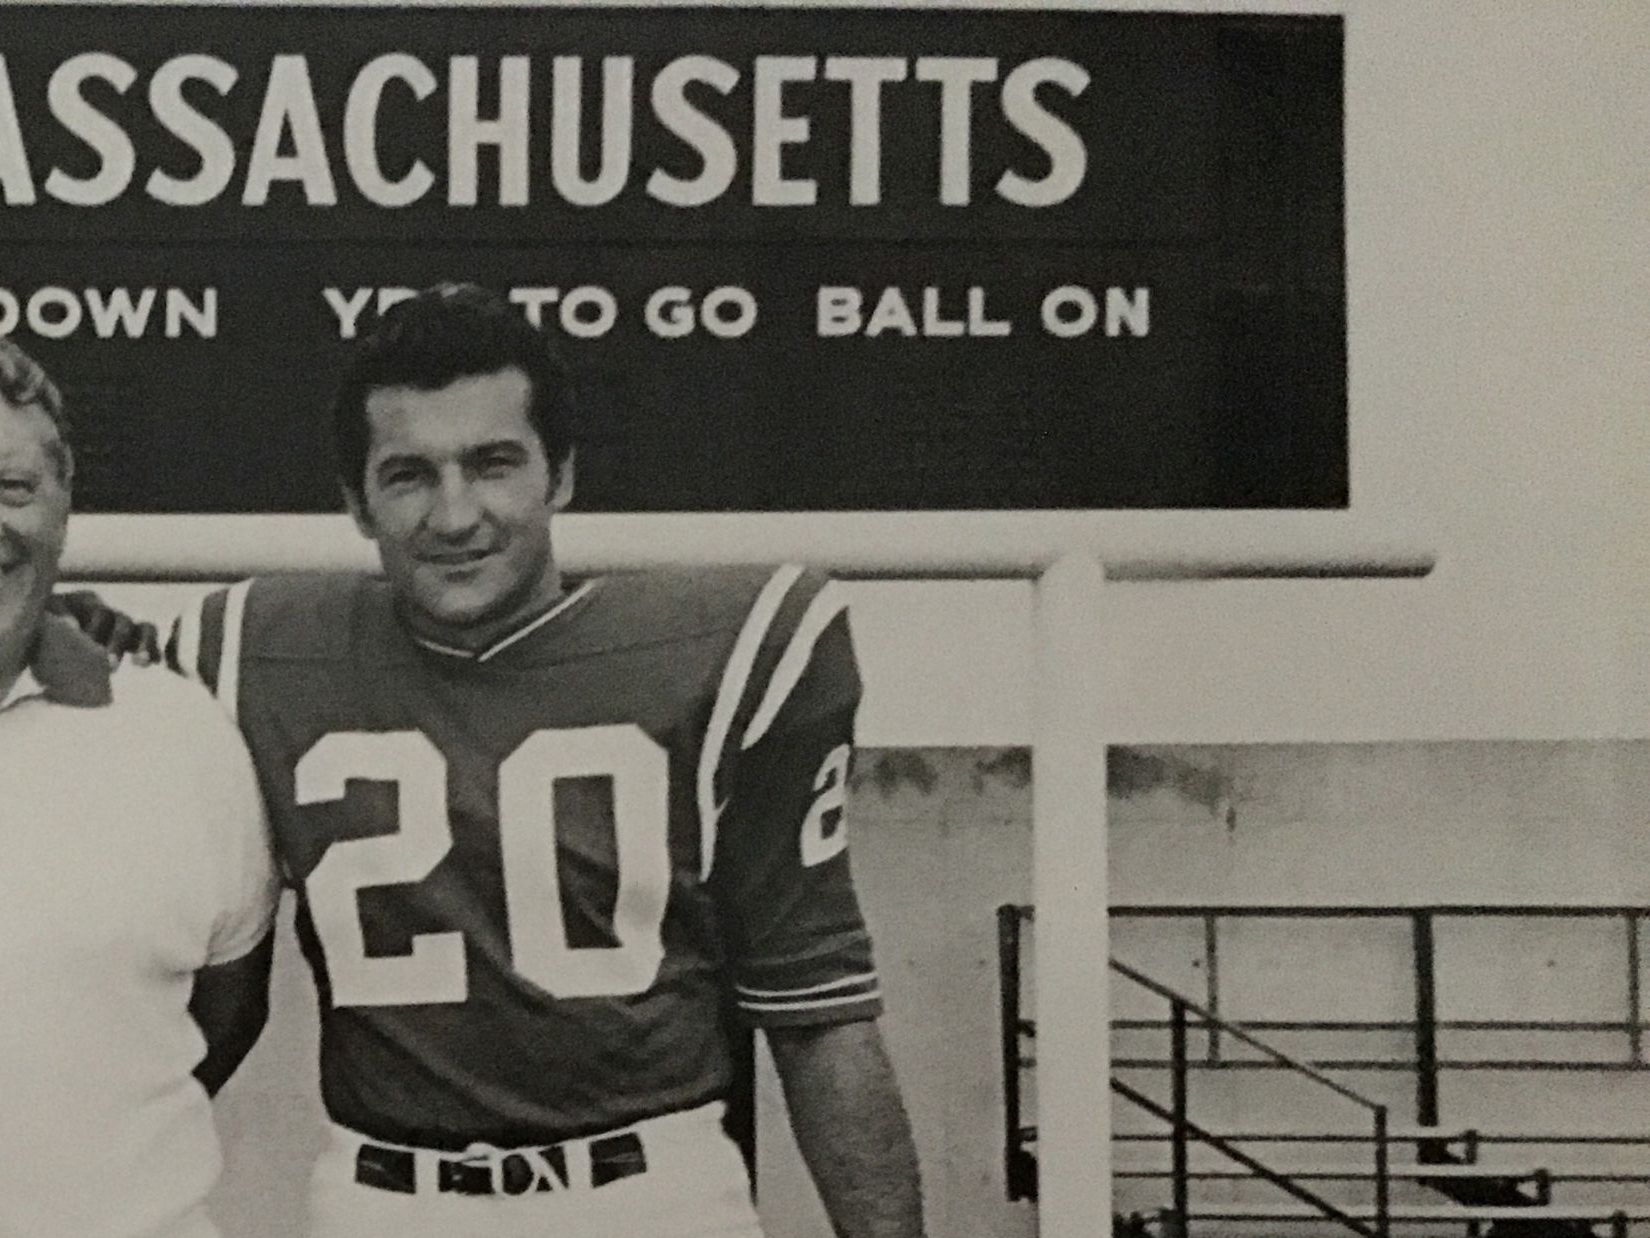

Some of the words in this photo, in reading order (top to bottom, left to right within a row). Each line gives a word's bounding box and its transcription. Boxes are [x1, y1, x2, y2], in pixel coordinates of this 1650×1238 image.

[507, 285, 618, 338] TO
[643, 285, 758, 338] GO
[816, 286, 1012, 338] BALL
[1040, 286, 1150, 338] ON
[294, 723, 670, 1007] 20
